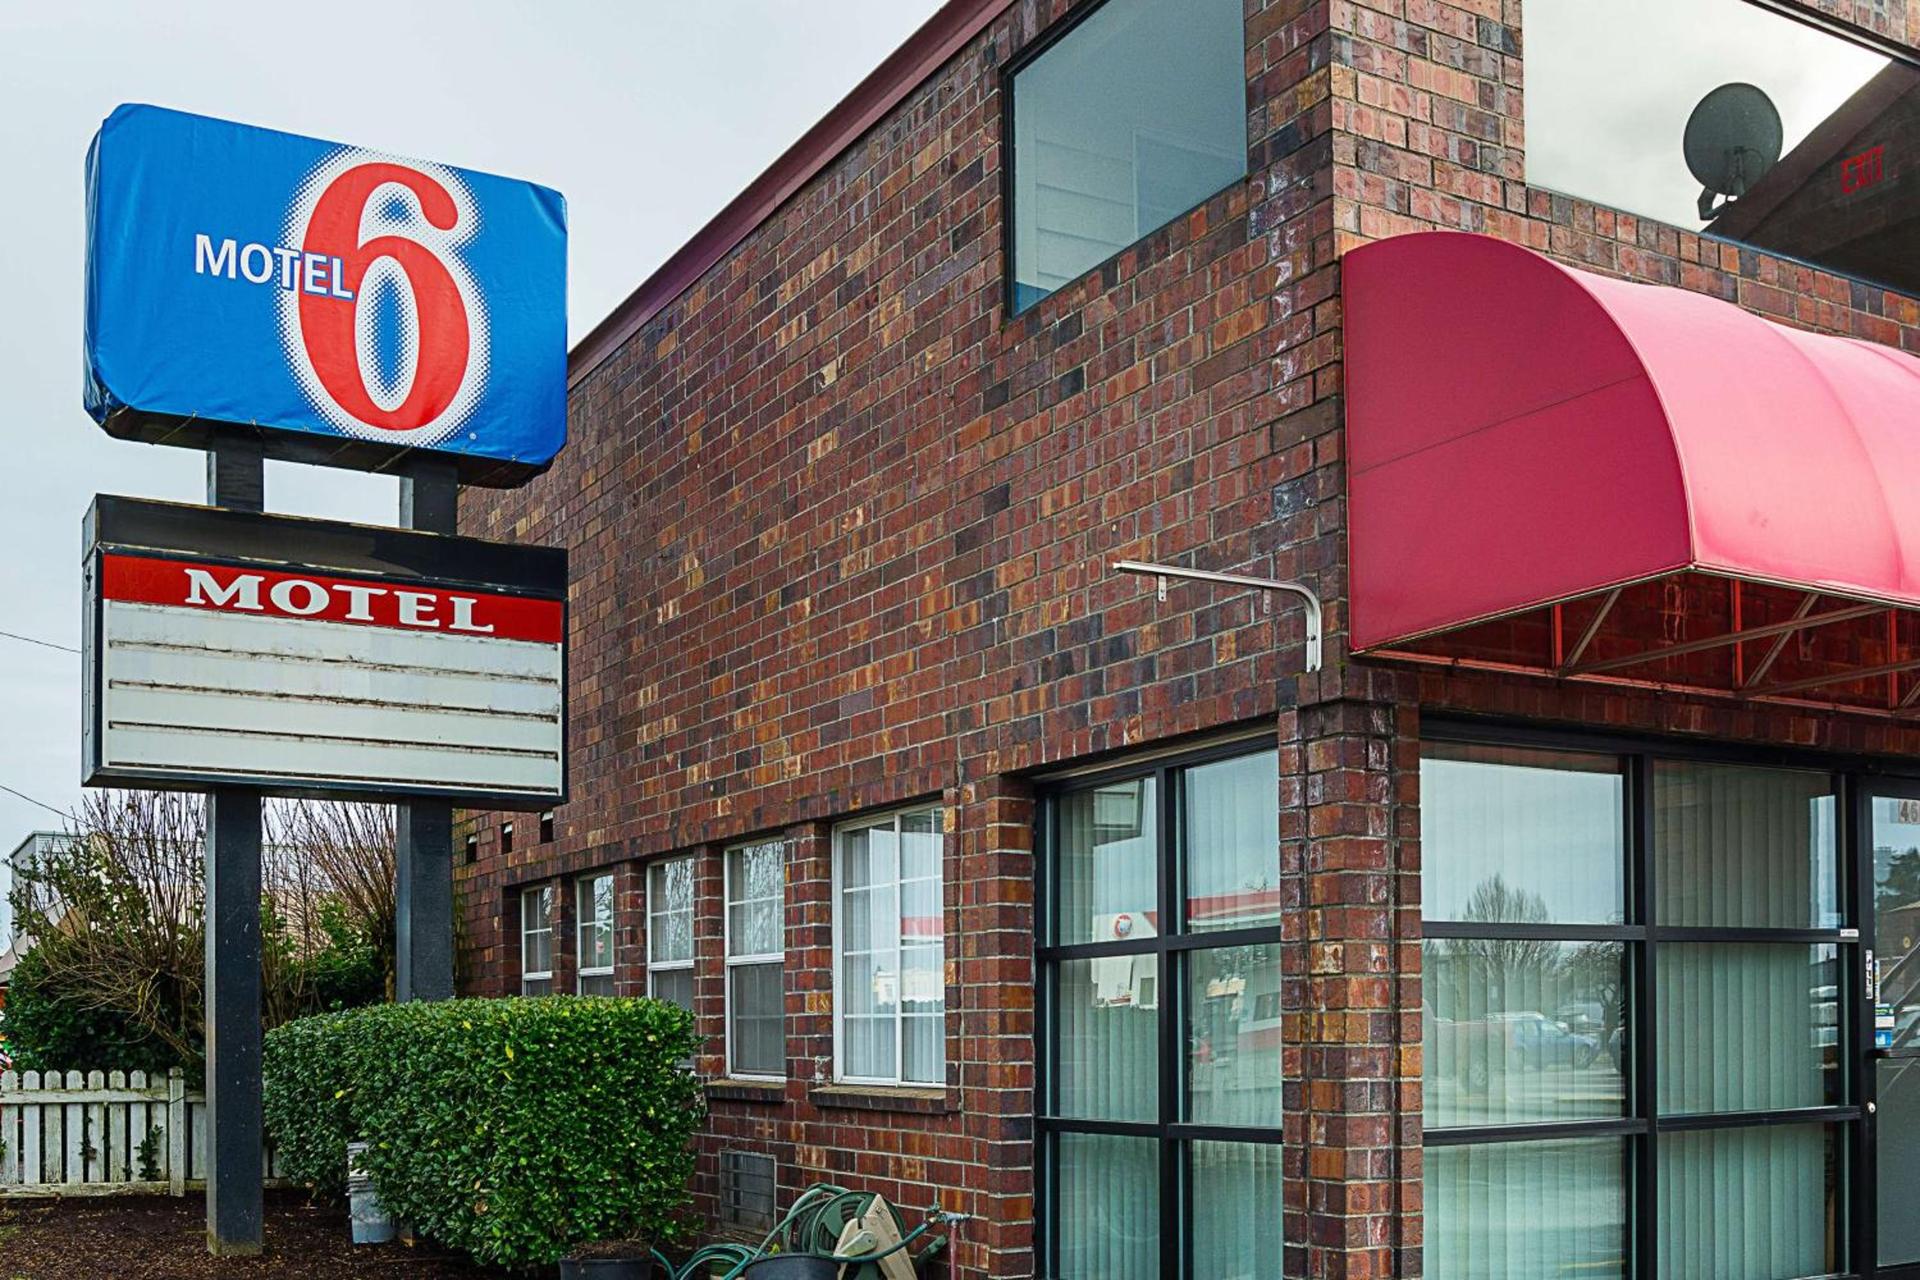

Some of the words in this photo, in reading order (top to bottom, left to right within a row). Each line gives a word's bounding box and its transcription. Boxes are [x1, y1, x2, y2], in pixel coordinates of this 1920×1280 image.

[1841, 145, 1885, 195] EXIT
[194, 233, 354, 299] MOTEL
[299, 161, 470, 431] 6
[183, 568, 494, 633] MOTEL
